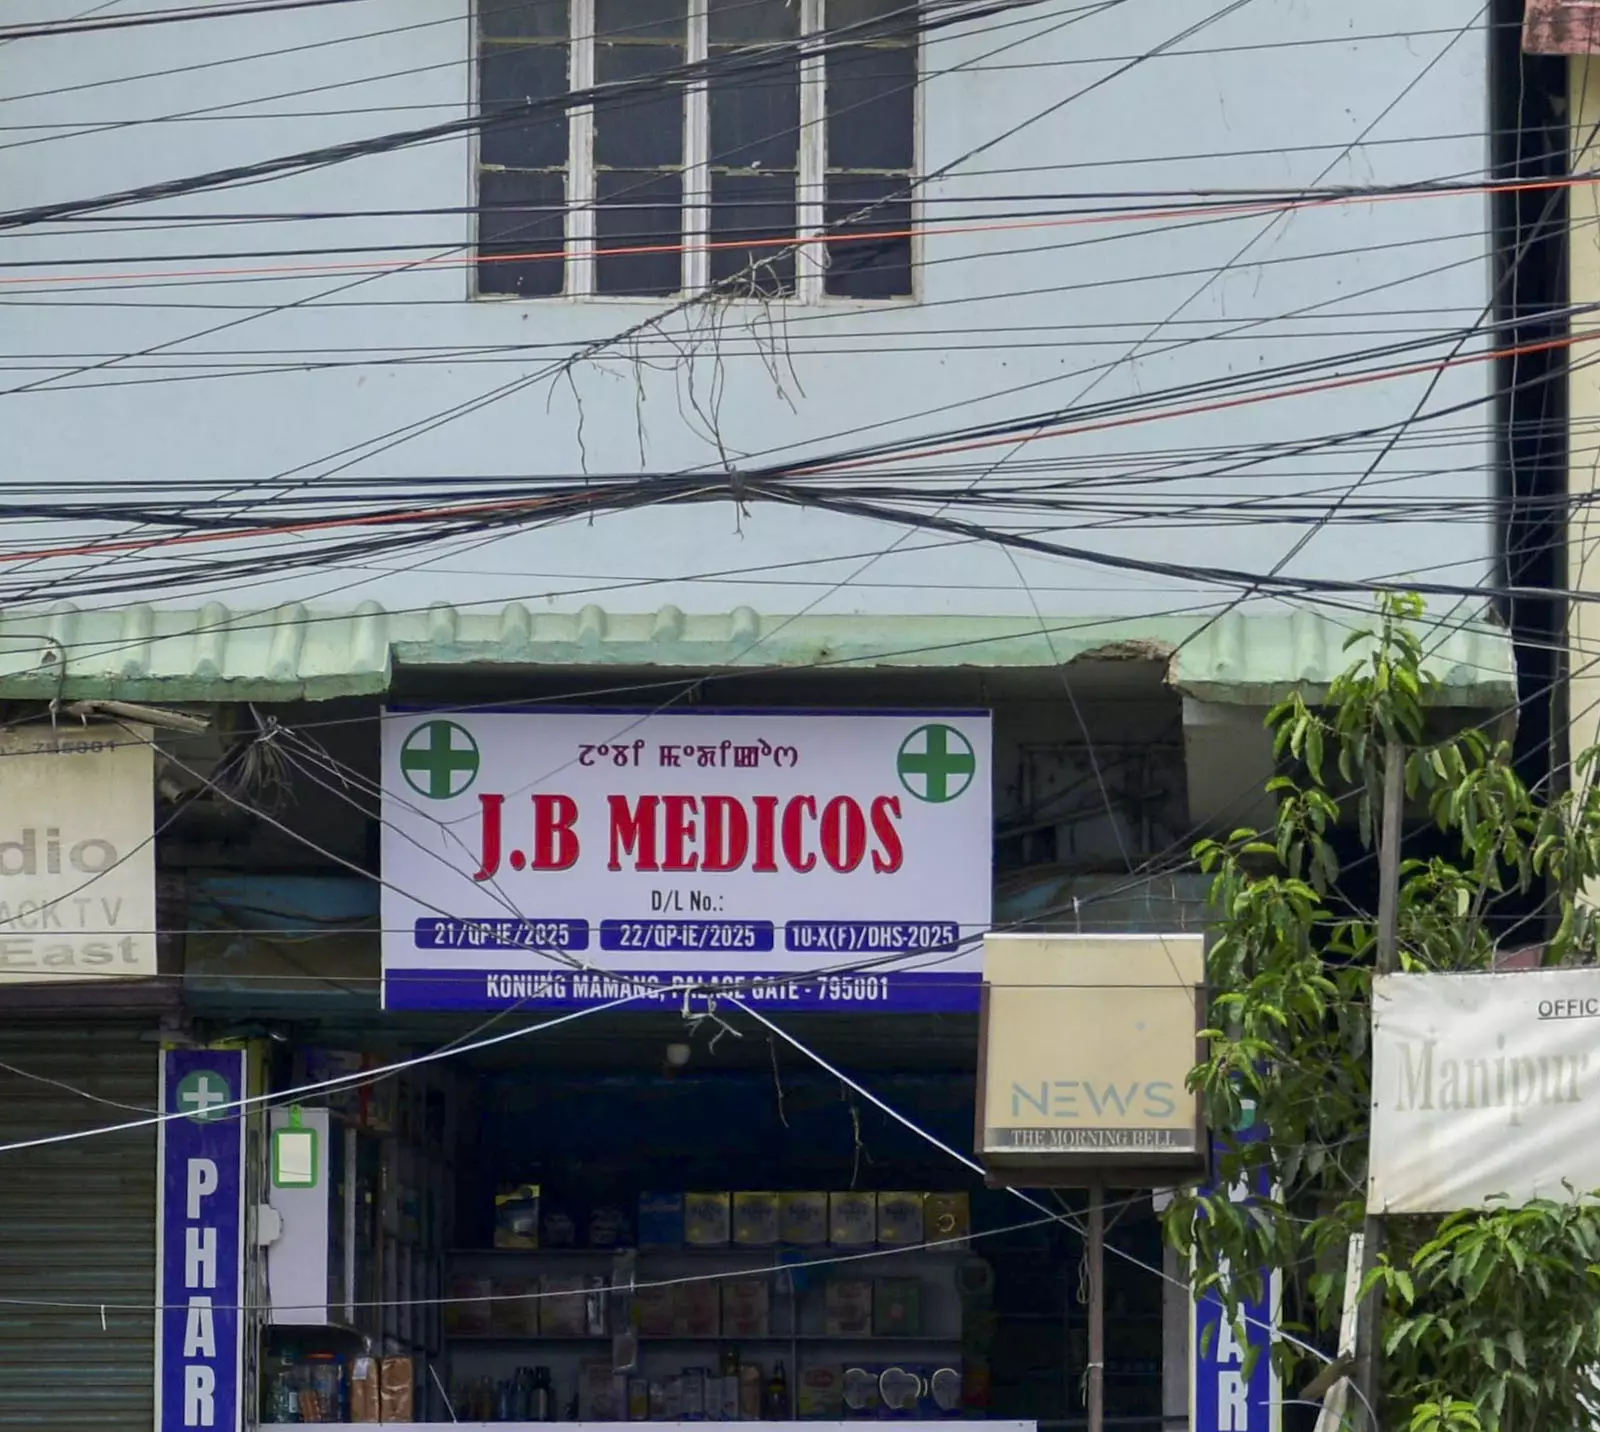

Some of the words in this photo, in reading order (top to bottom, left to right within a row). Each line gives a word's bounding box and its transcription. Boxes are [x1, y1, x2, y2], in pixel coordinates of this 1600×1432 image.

[473, 793, 581, 883] J.B
[607, 793, 904, 874] MEDICOS
[651, 890, 683, 913] D/L
[486, 974, 567, 999] KONUNG
[752, 976, 800, 1000] GATE
[817, 976, 889, 1000] 795001
[1395, 1033, 1591, 1127] Manipur
[1011, 1080, 1176, 1118] NEWS
[1011, 1130, 1045, 1147] THE
[1050, 1130, 1128, 1147] MORNING
[1132, 1130, 1176, 1147] BELL
